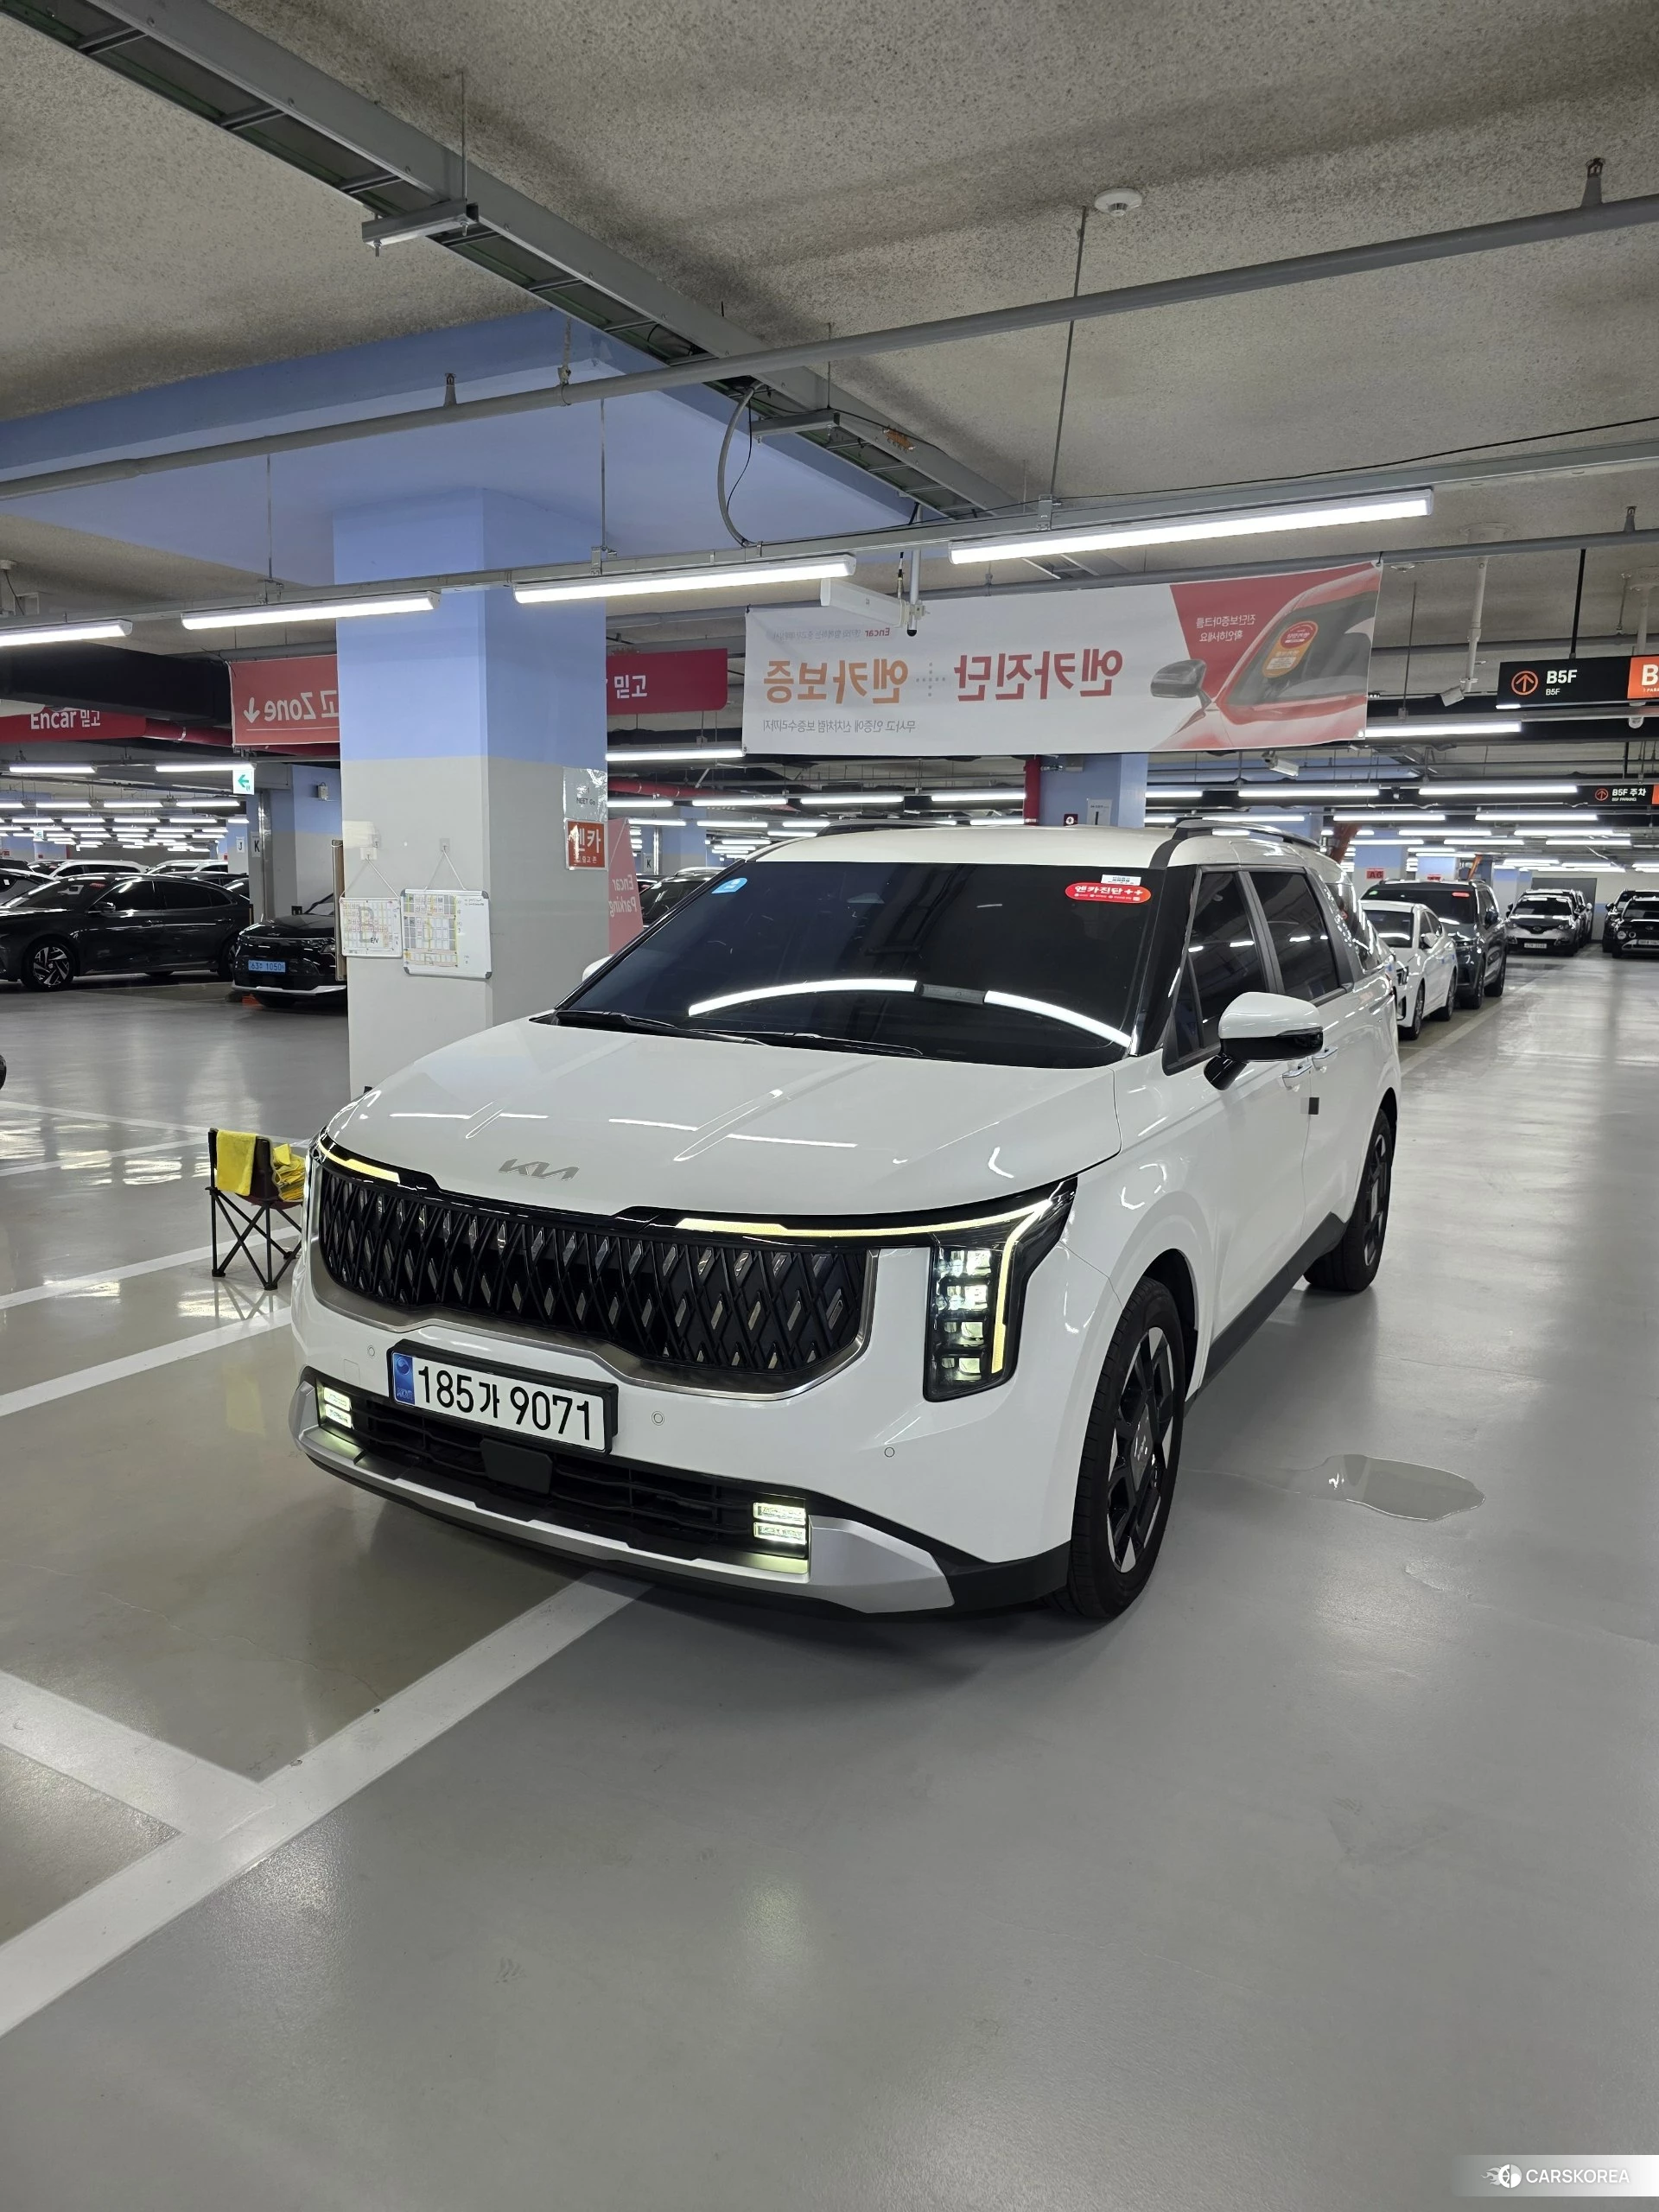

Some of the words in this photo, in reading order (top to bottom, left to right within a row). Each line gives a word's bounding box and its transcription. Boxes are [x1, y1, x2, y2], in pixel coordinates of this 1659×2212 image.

[1546, 670, 1578, 684] B5F
[614, 675, 647, 699] 믿고
[30, 709, 76, 730] Encar
[79, 709, 101, 728] 믿고
[1630, 787, 1647, 797] 주차
[238, 842, 243, 851] J
[254, 840, 261, 853] K
[646, 859, 652, 868] K
[266, 963, 282, 971] 1050
[499, 1159, 580, 1181] KIA
[418, 1366, 499, 1419] 185가
[510, 1386, 590, 1440] 9071
